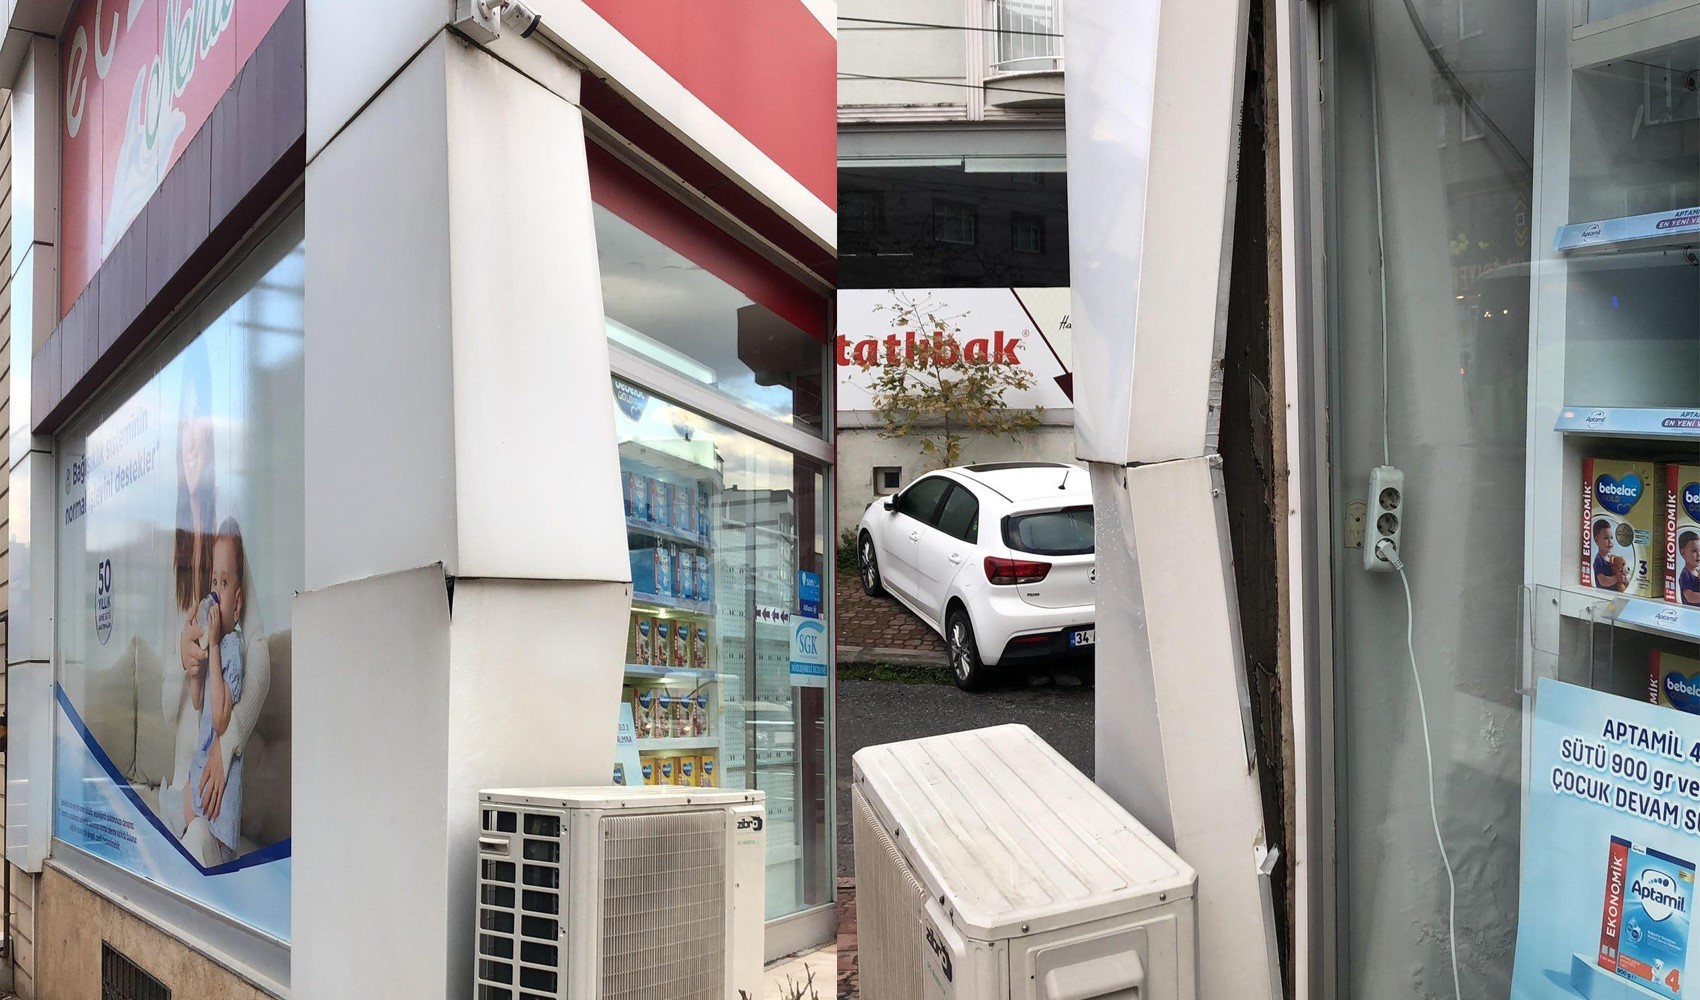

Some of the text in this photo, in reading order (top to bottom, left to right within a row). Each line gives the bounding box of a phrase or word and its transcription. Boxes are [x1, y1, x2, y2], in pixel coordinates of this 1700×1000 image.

[1599, 482, 1637, 498] bebelac
[65, 489, 87, 526] normal
[97, 558, 112, 596] 50
[1638, 560, 1648, 576] 3
[799, 633, 818, 655] SGK
[1075, 631, 1090, 645] 34
[1602, 719, 1683, 758] APTAMİL
[1561, 738, 1700, 797] SÜTÜ 900 gr ve
[1552, 768, 1700, 833] ÇOCUK DEVAM S
[1631, 880, 1686, 914] Aptamil
[1665, 968, 1680, 993] 4
